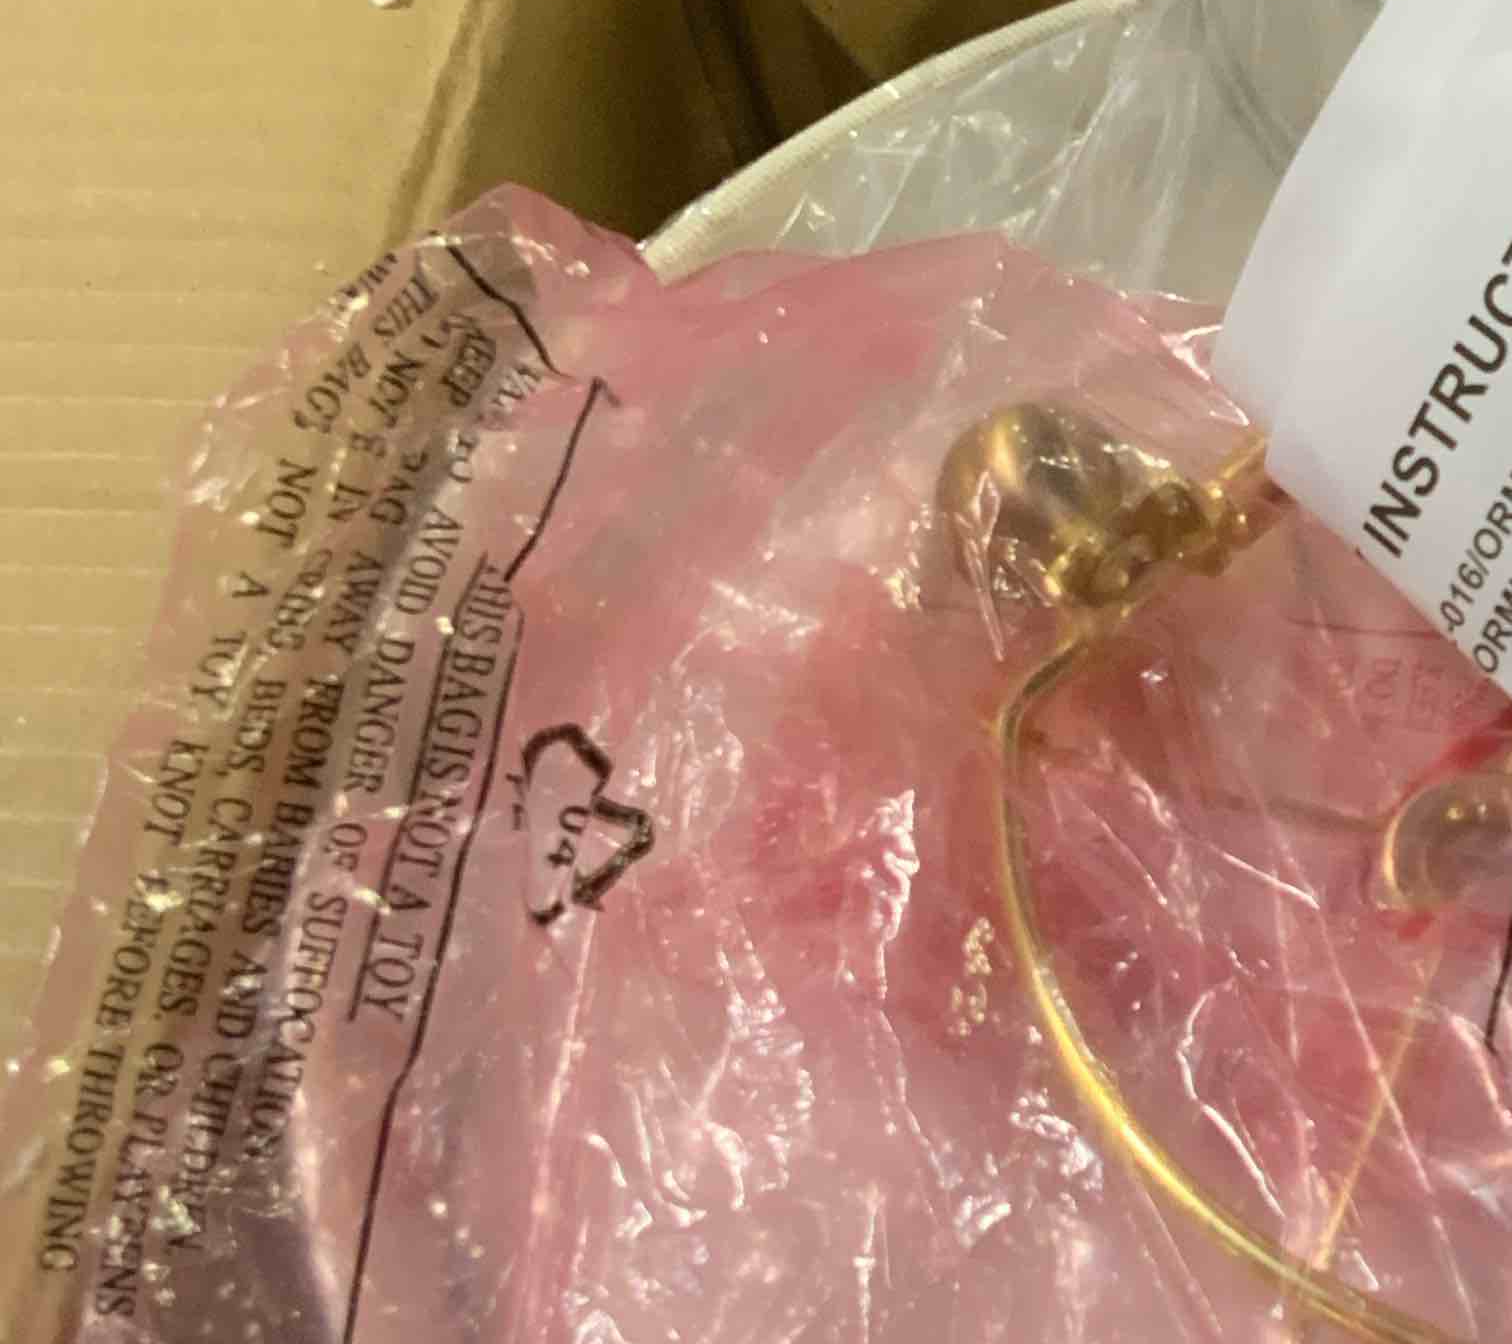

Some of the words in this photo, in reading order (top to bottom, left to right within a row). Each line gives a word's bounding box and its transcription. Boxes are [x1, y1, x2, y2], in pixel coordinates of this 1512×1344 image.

[253, 455, 319, 550] NOT
[230, 569, 273, 606] A
[318, 547, 386, 659] AWAY
[392, 502, 466, 624] AVOID
[279, 675, 347, 793] FROM
[338, 633, 417, 801] DANGER
[432, 644, 500, 743] BAG
[140, 734, 211, 849] KNOT
[422, 739, 475, 788] IS
[393, 787, 462, 881] NOT
[387, 884, 434, 919] A
[210, 947, 272, 1044] AND
[359, 925, 426, 1024] TOY
[131, 1037, 188, 1105] OR
[30, 1037, 135, 1280] THROWING
